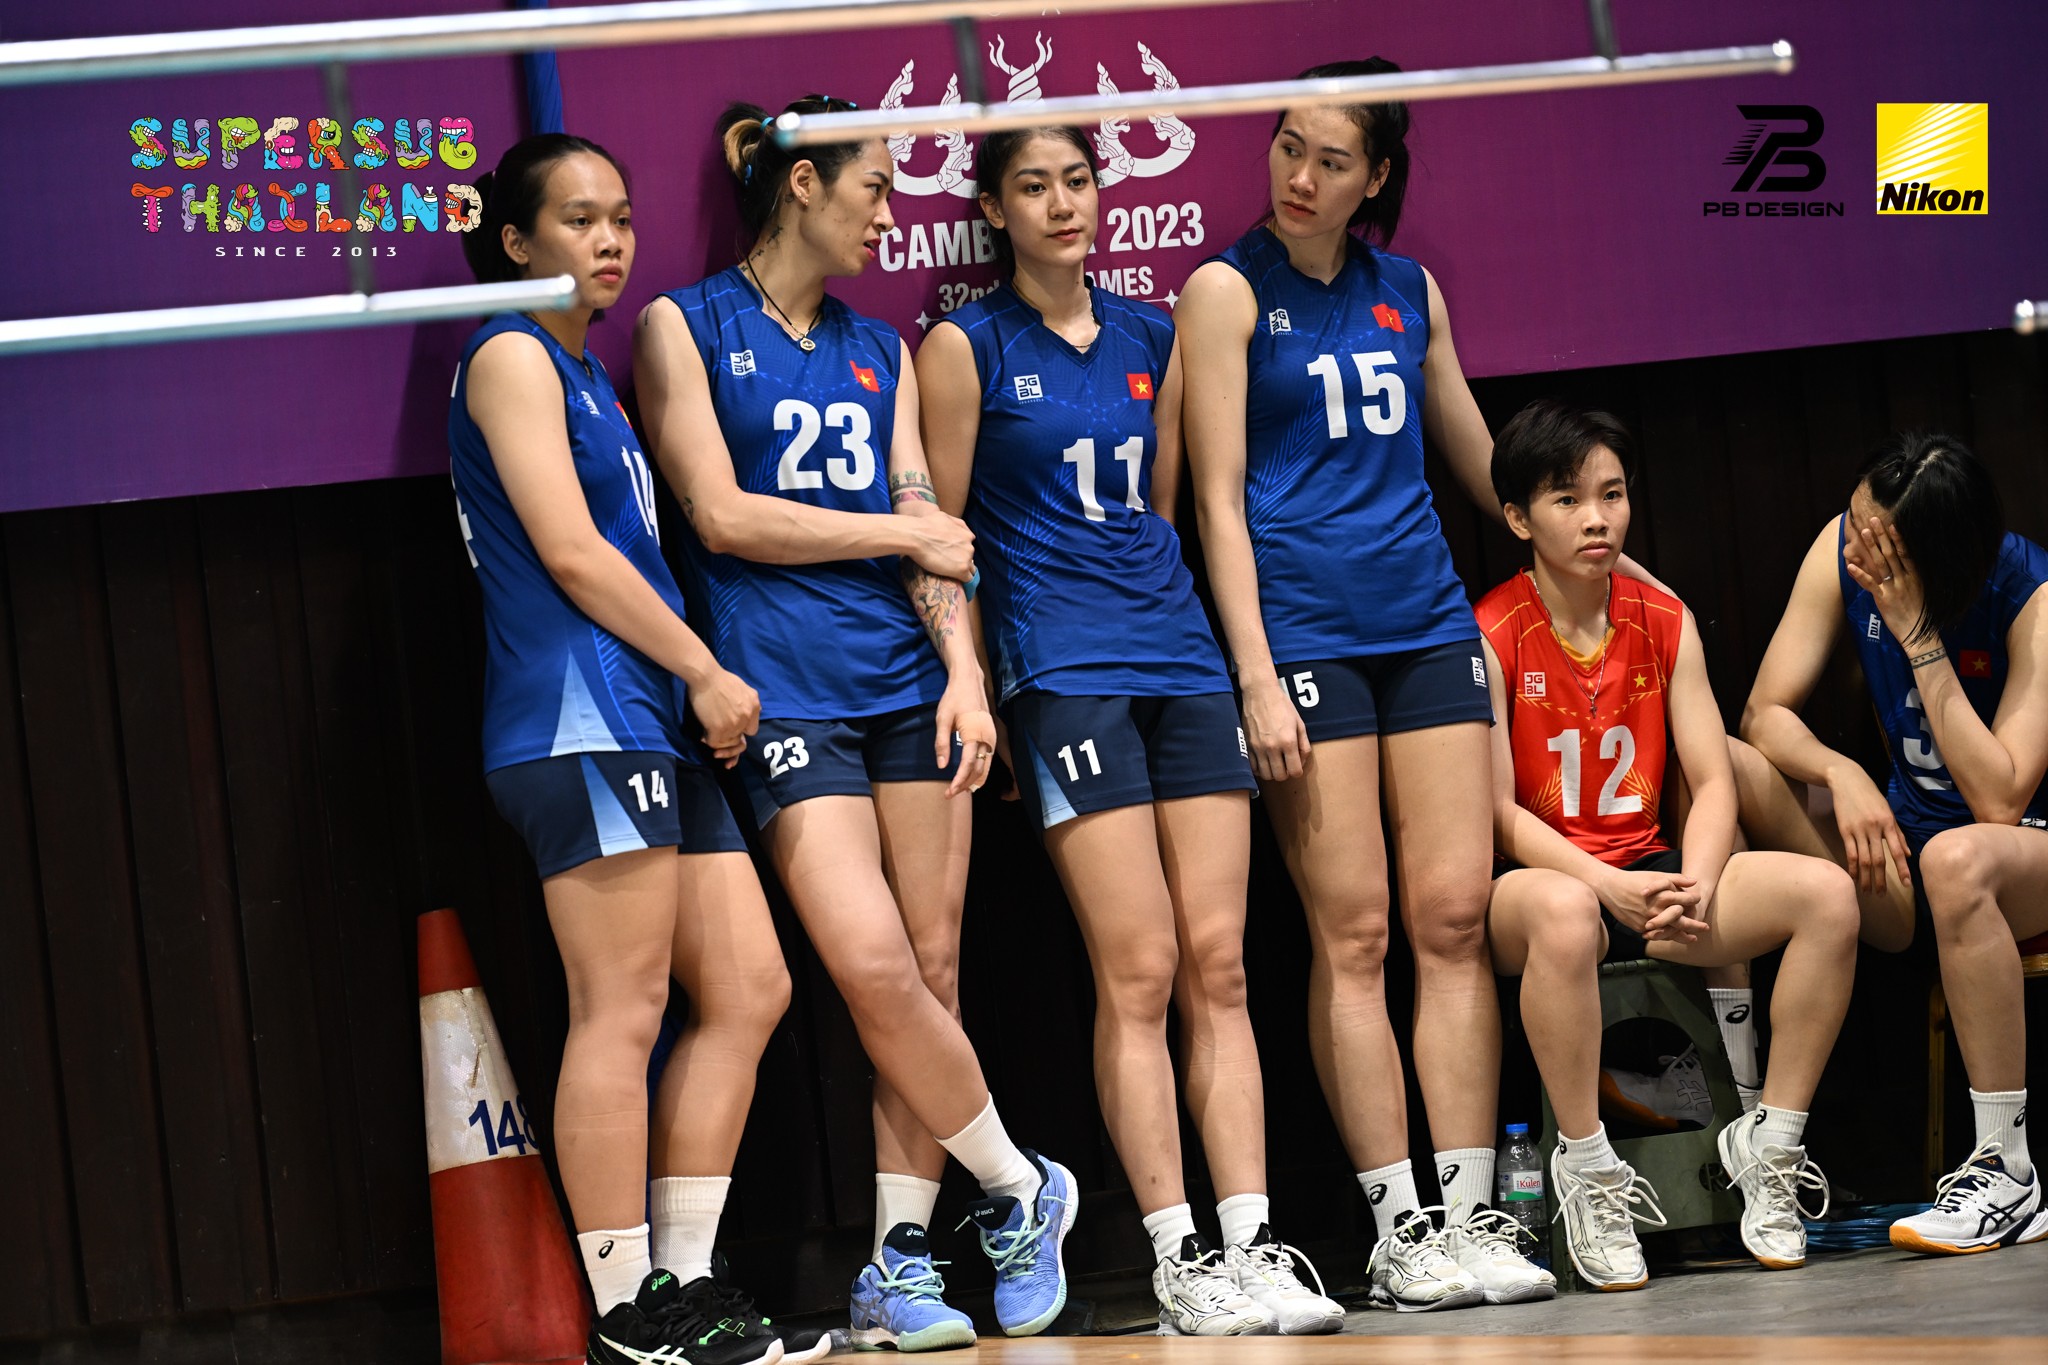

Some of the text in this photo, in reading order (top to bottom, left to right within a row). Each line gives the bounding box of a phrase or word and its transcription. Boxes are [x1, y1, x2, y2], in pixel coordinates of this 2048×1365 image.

[1106, 201, 1206, 253] 2023
[1306, 350, 1407, 439] 15
[773, 399, 876, 491] 23
[1063, 436, 1146, 522] 11
[621, 446, 660, 547] 14
[627, 770, 669, 812] 14
[763, 736, 810, 779] 23
[1057, 738, 1102, 782] 11
[1547, 724, 1643, 817] 12
[1520, 1180, 1541, 1189] Kulen
